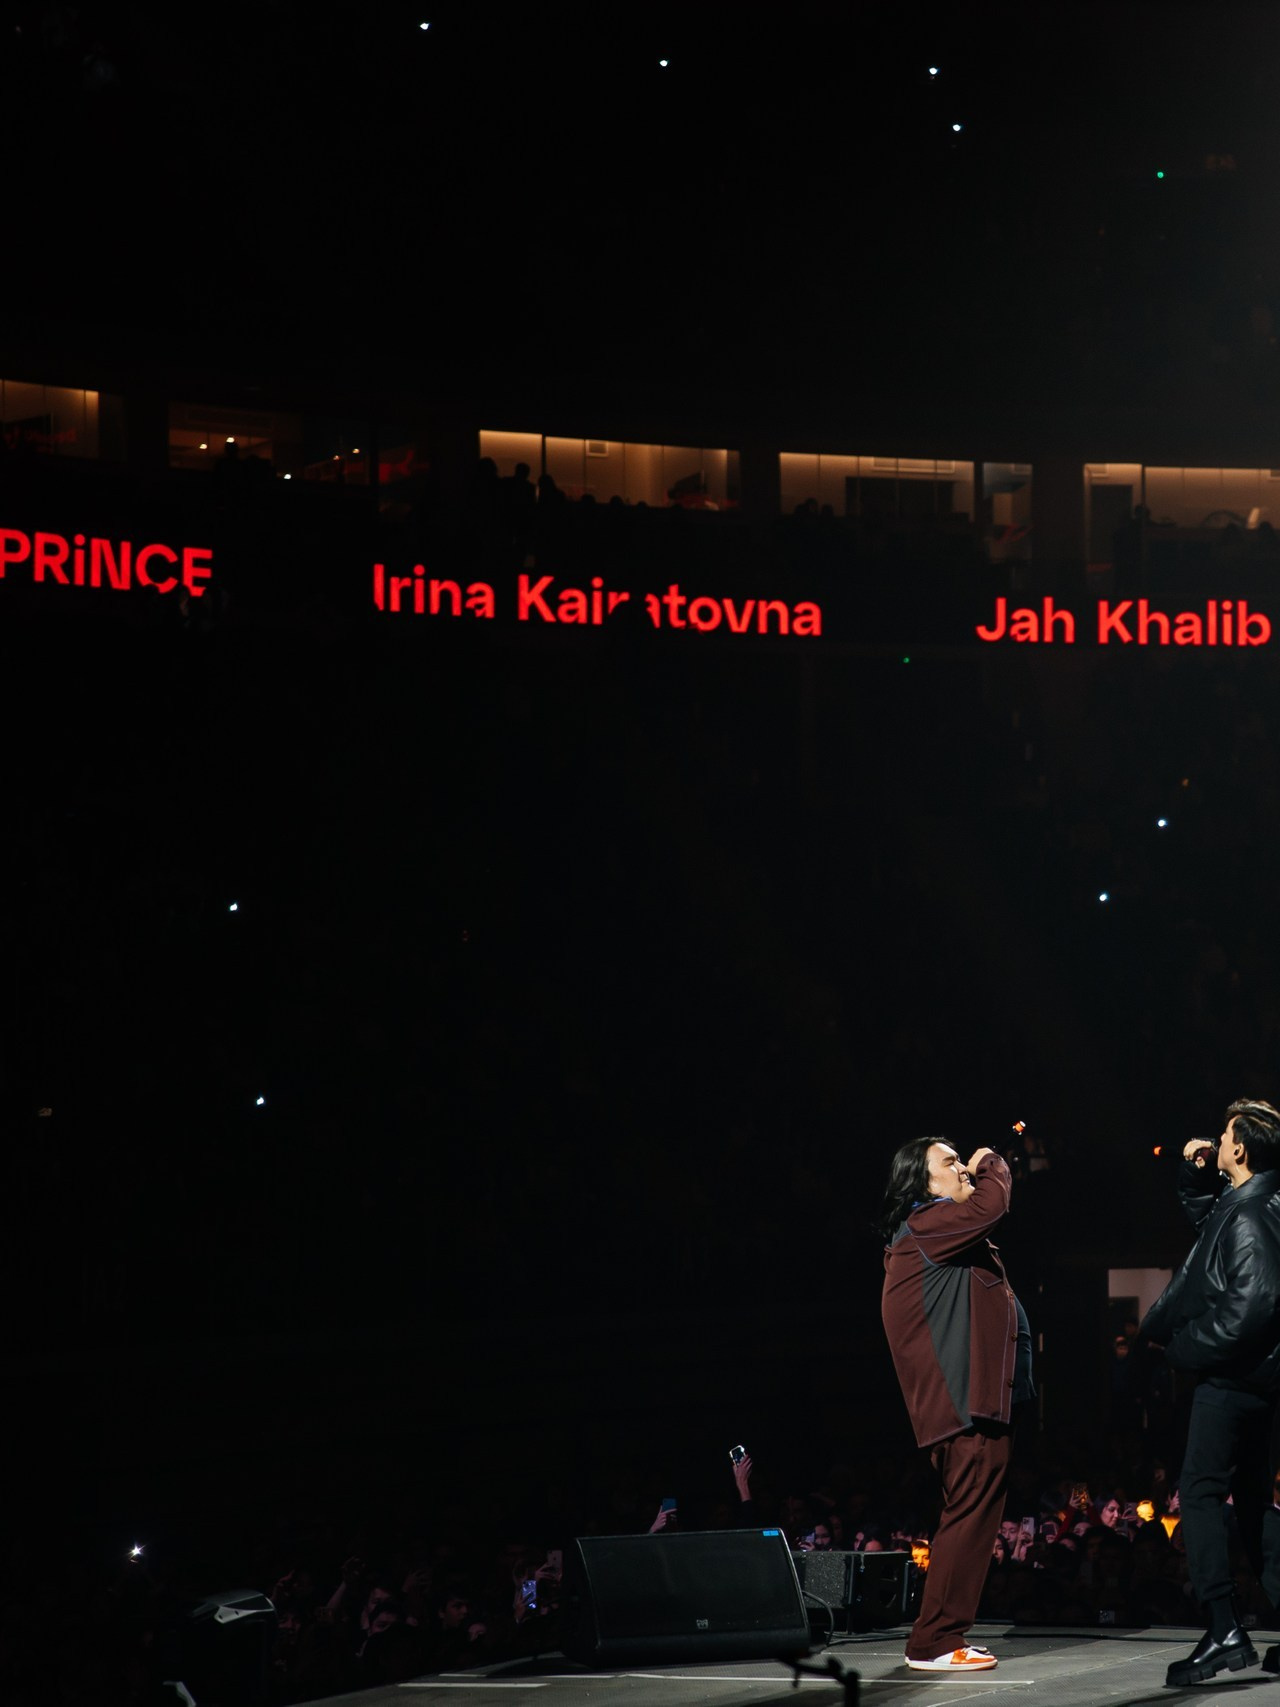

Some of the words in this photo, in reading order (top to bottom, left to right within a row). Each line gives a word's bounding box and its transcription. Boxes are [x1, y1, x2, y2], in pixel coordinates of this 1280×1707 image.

[0, 528, 213, 597] PRiNCE
[373, 563, 496, 619] Irina
[976, 596, 1075, 644] Jah
[1098, 598, 1272, 646] Khalib
